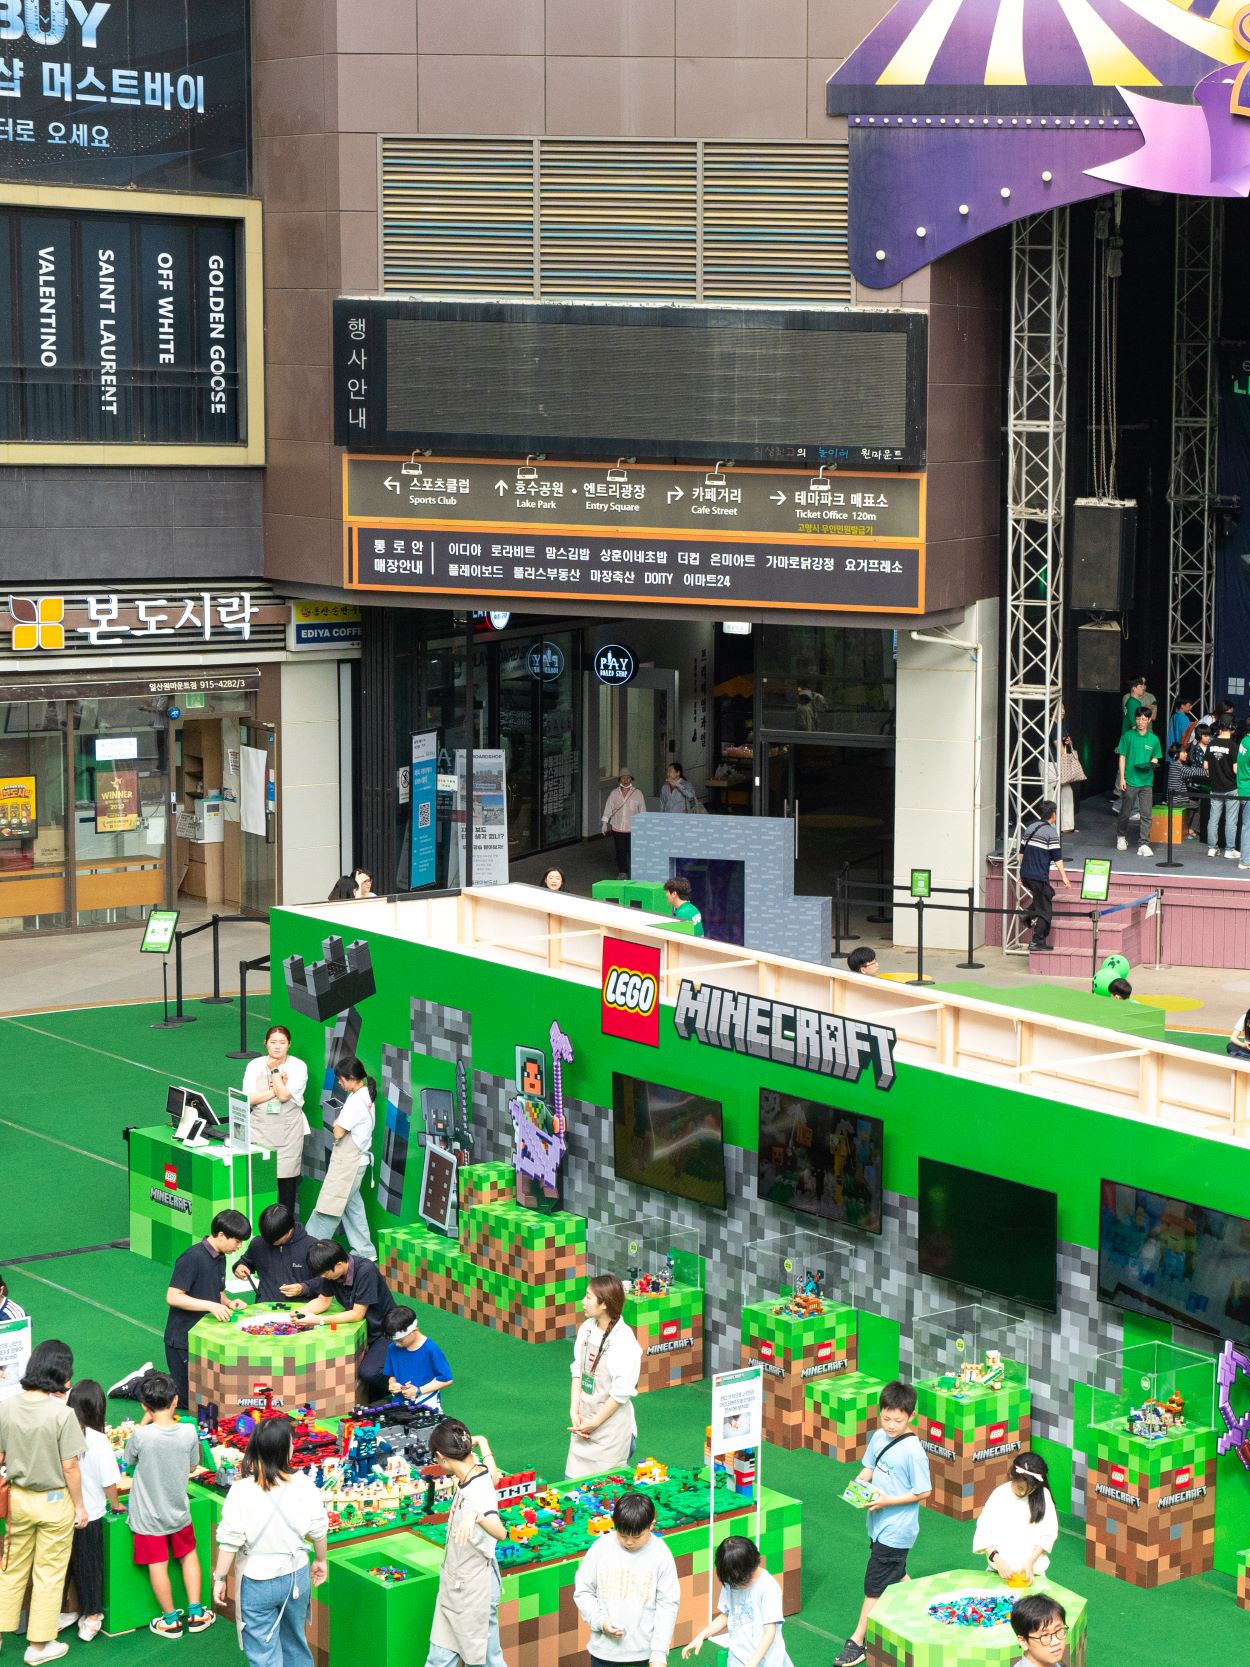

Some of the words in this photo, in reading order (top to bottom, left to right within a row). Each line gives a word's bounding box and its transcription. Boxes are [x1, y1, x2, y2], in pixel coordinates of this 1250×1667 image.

[42, 61, 204, 113] 머스트바이
[47, 121, 110, 148] 오세요
[98, 249, 116, 314] SAINT
[157, 252, 174, 291] OFF
[39, 246, 57, 367] VALENTINO
[208, 255, 225, 339] GOLDEN
[158, 296, 175, 364] WHITE
[100, 319, 118, 415] LAURENT
[210, 345, 226, 414] GOOSE
[861, 447, 904, 461] 원마운트
[409, 496, 437, 506] Sports
[437, 496, 457, 506] Club
[410, 478, 470, 494] 스포츠클럽
[514, 481, 564, 497] 호수공원
[583, 483, 646, 500] 엔트리광장
[691, 487, 742, 504] 카페거리
[794, 491, 846, 507] 테마파크
[850, 492, 889, 508] 매표소
[516, 500, 537, 509] Lake
[537, 500, 557, 510] Park
[585, 501, 609, 513] Entry
[609, 503, 640, 513] Square
[691, 505, 711, 515] Cafe
[711, 506, 738, 516] Street
[794, 509, 822, 519] Ticket
[822, 510, 849, 520] Office
[852, 511, 877, 521] 120m
[448, 542, 482, 557] 이디야
[491, 544, 536, 559] 로라비트
[545, 546, 590, 561] 맘스김밥
[600, 548, 668, 565] 상훈이네초밥
[677, 551, 700, 566] 더컵
[710, 553, 756, 568] 은미아트
[765, 555, 835, 571] 가마로닭강정
[844, 558, 903, 574] 요거프레소
[373, 558, 424, 575] 매장안내
[448, 563, 503, 578] 플레이보드
[513, 566, 581, 582] 플러스부동산
[590, 569, 635, 585] 마장축산
[644, 572, 674, 586] DOITY
[683, 573, 731, 588] 이마트24
[77, 591, 260, 645] 본도시락
[301, 628, 331, 638] EDIYA
[332, 626, 362, 637] COFFE
[199, 679, 246, 690] 915-4282/3
[101, 790, 133, 800] WINNER
[604, 967, 656, 1015] LEGO
[674, 979, 897, 1091] MINECRAFT
[150, 1185, 192, 1215] MINECRAFT
[647, 1337, 695, 1357] MINECRAFT
[800, 1358, 849, 1379] MINECRAFT
[972, 1440, 1022, 1463] MINECRAFT
[498, 1483, 532, 1499] TNT
[1095, 1482, 1141, 1509] MINECRAFT
[1157, 1485, 1207, 1509] MINECRAFT
